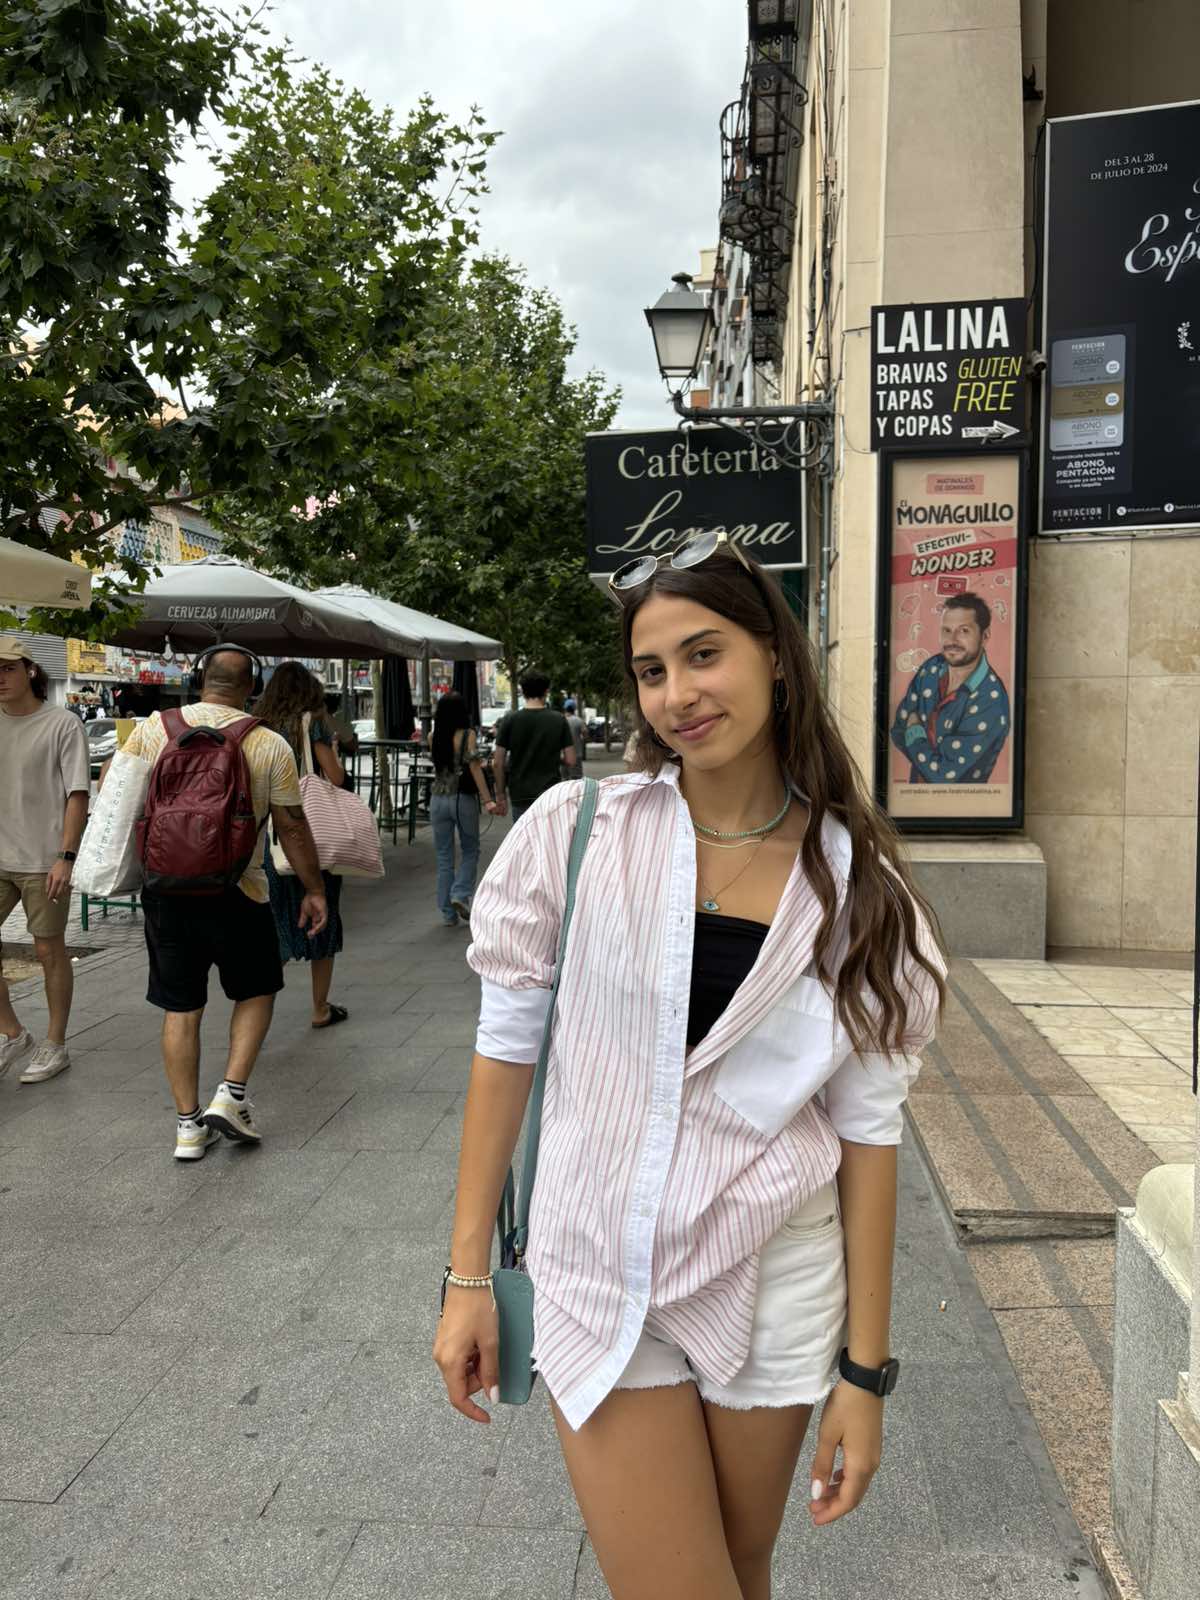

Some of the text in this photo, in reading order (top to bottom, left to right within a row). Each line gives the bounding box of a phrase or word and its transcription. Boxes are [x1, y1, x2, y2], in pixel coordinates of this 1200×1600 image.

[1104, 153, 1155, 167] DEL 3 AL 28
[1090, 163, 1168, 180] DE JULIO DE 2024
[877, 306, 1010, 354] LALINA
[877, 362, 948, 385] BRAVAS
[958, 356, 1023, 379] GLUTEN
[876, 389, 934, 411] TAPAS
[953, 381, 1018, 413] FREE
[876, 415, 953, 437] Y COPAS
[1056, 466, 1116, 478] PENTACIÓN
[1067, 459, 1105, 469] ABONO
[896, 502, 1014, 525] MONAGUILLO
[910, 548, 995, 576] WONDER
[168, 606, 277, 621] CERVEZAS ALHAMBRA
